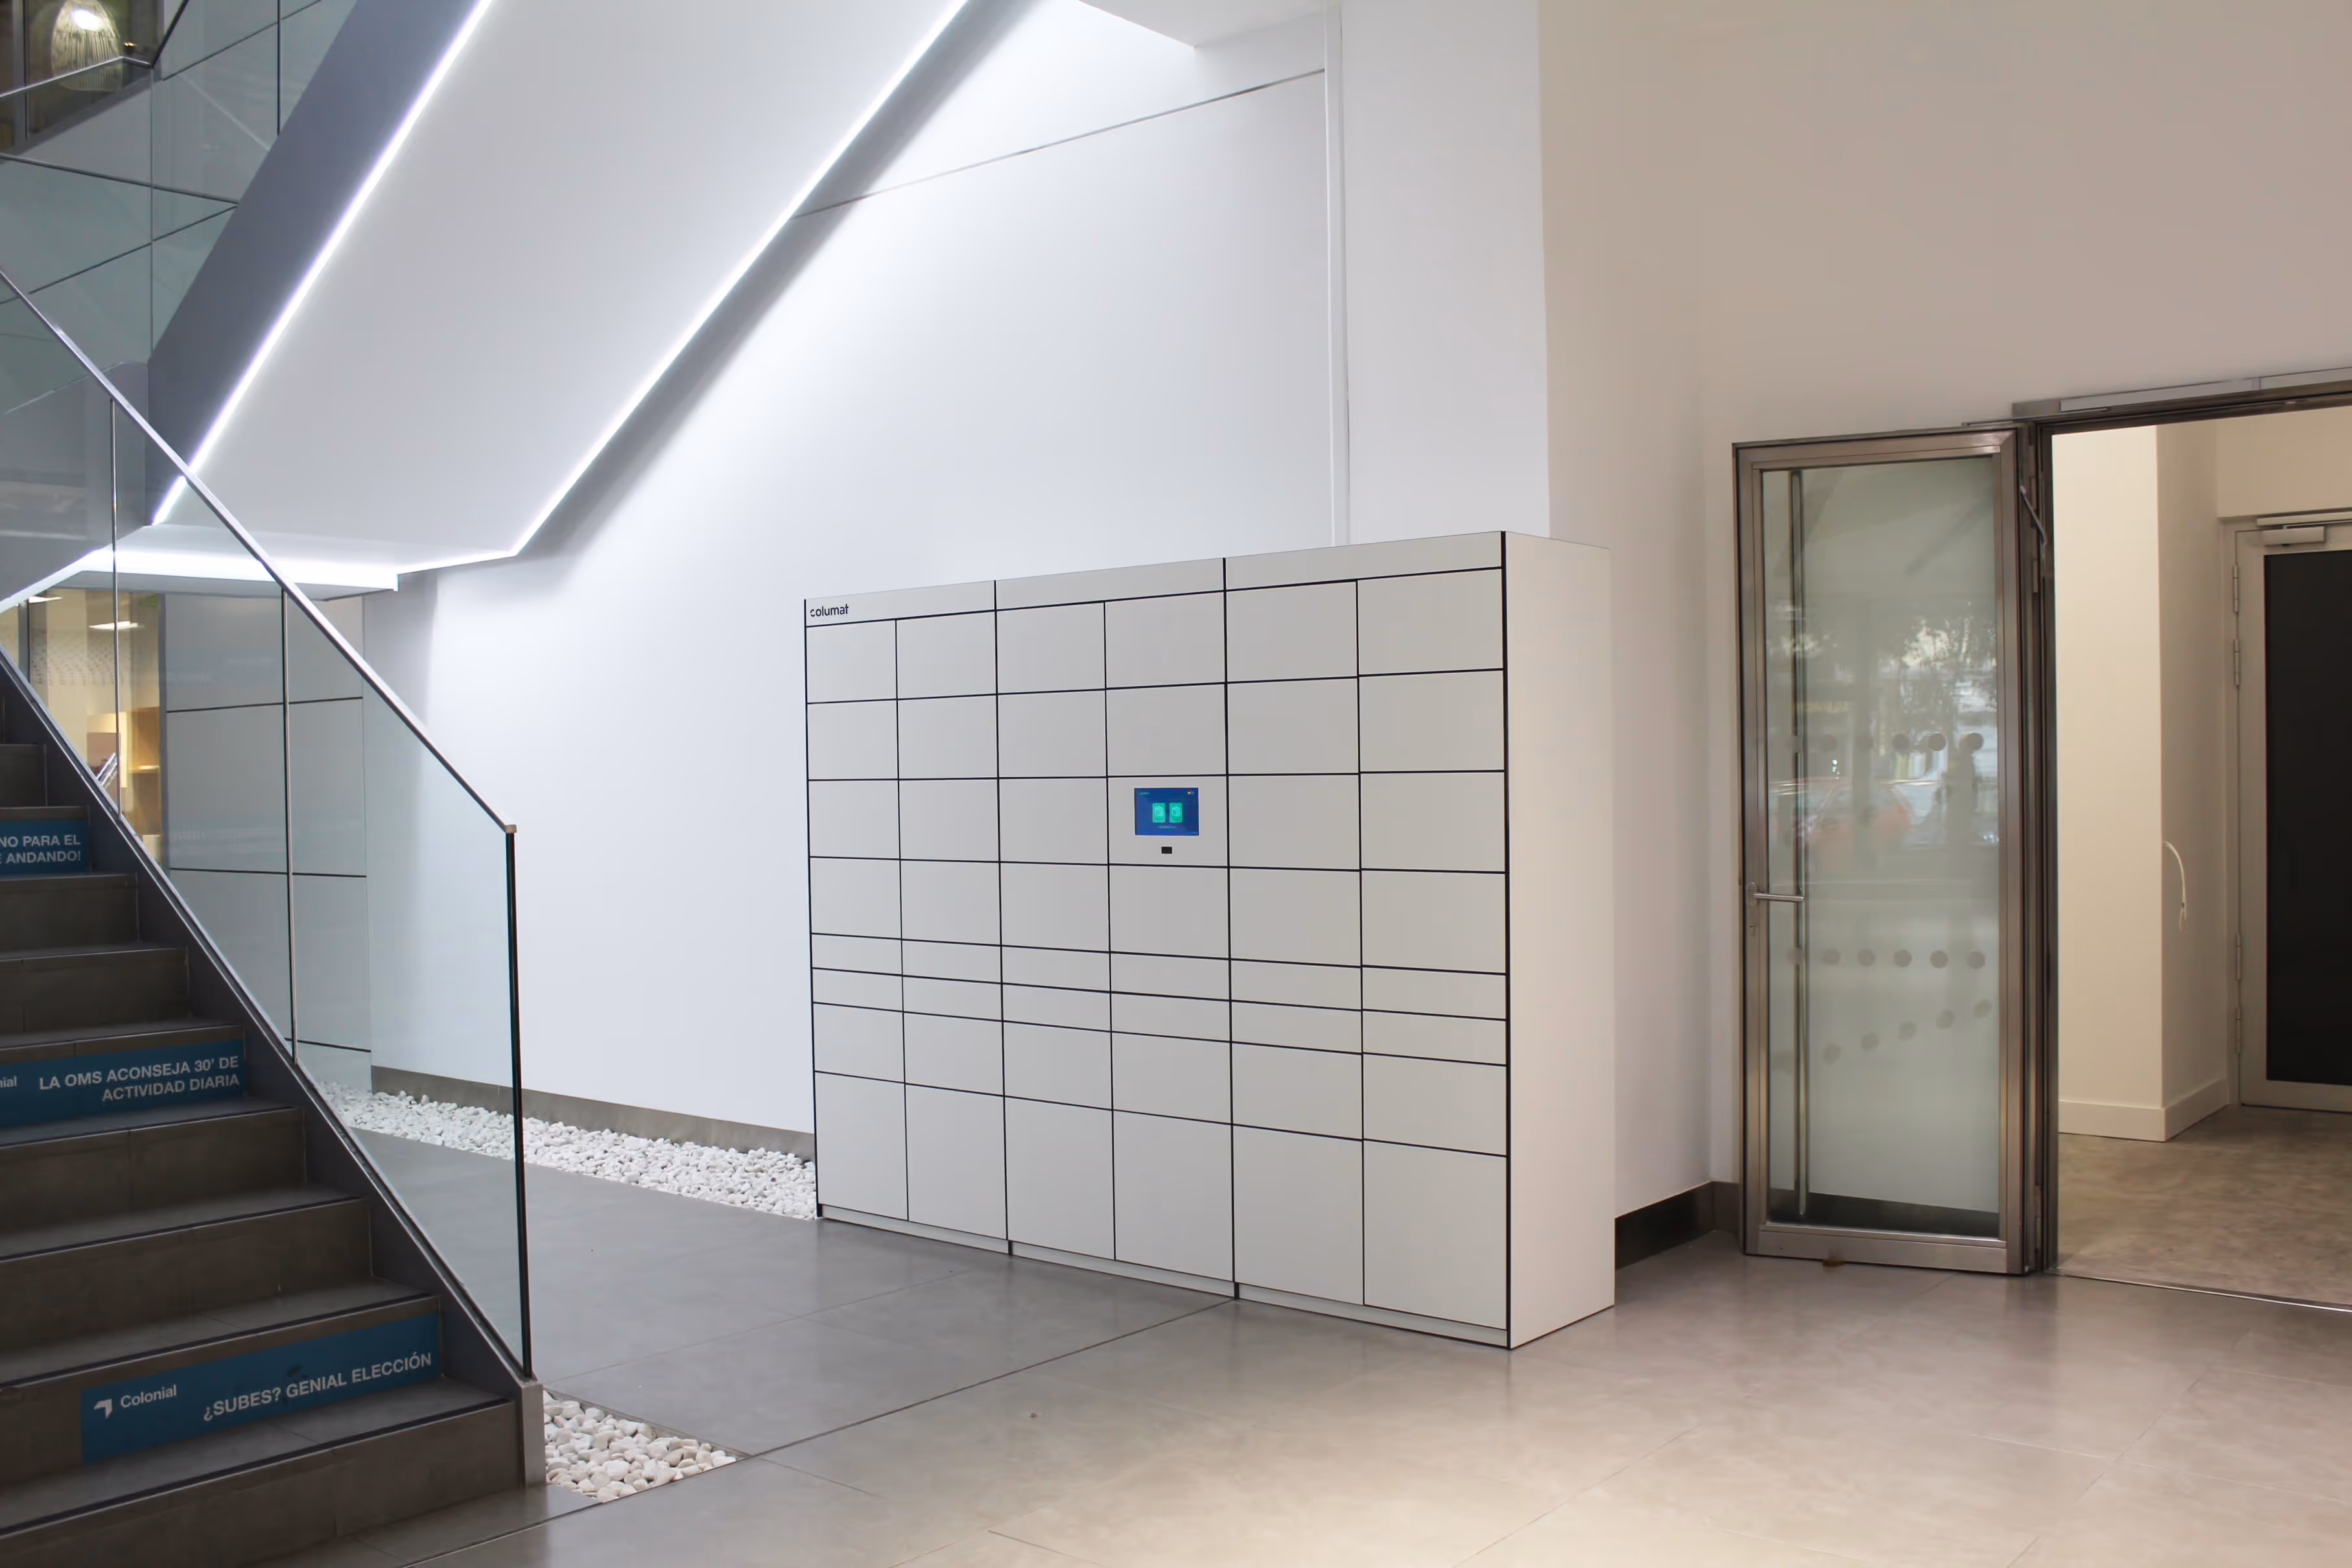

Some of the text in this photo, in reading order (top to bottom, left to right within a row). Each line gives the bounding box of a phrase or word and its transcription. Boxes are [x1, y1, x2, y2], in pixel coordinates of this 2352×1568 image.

[810, 603, 849, 617] columat
[23, 835, 60, 846] PARA
[64, 834, 81, 845] EL
[6, 850, 81, 863] ANDANDO!
[39, 1056, 239, 1090] LA OMS ACONSEJA 30' DE
[102, 1073, 240, 1101] ACTIVIDAD DIARIA
[120, 1384, 177, 1409] Colonial
[204, 1351, 432, 1422] ¿SUBES? GENIAL ELECCIÓN
